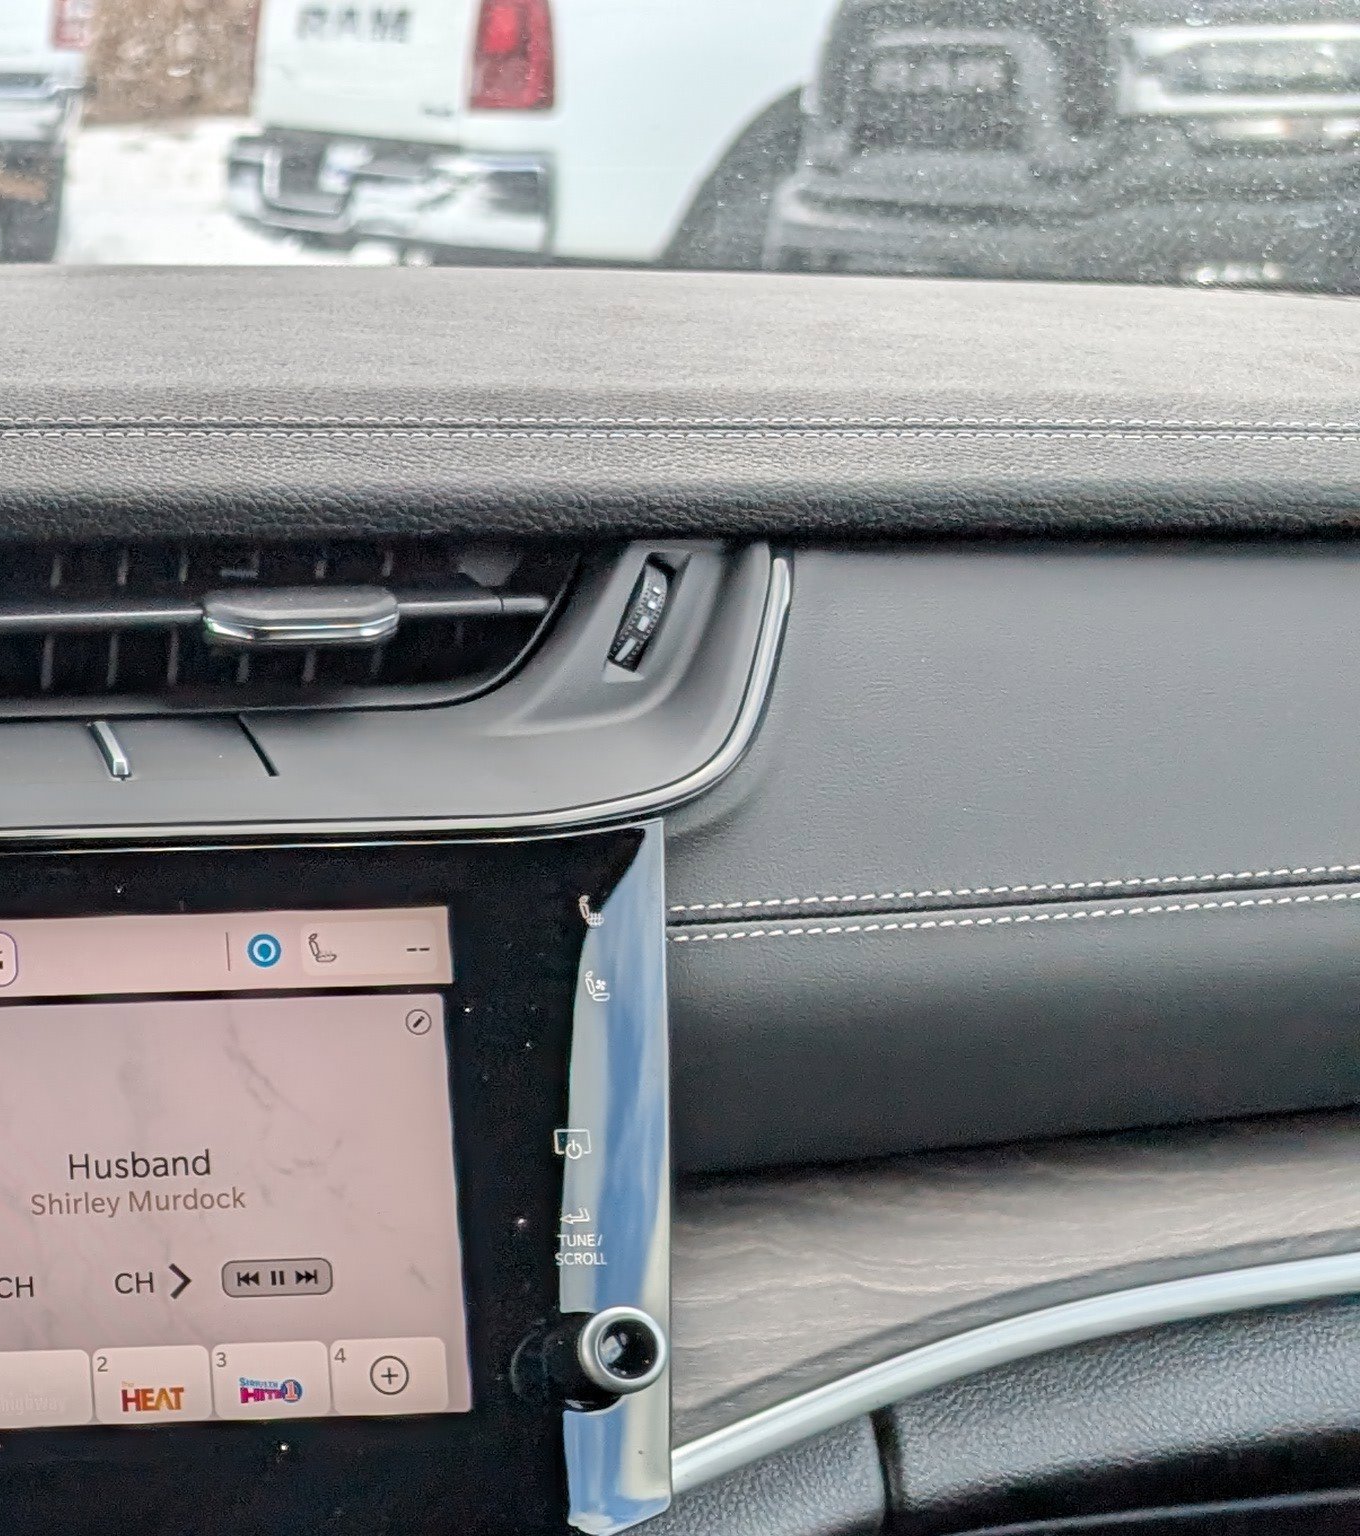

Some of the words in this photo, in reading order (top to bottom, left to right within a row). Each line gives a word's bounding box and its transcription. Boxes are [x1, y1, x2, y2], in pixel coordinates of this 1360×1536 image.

[68, 1149, 212, 1181] Husband
[31, 1190, 120, 1219] Shirley
[128, 1186, 247, 1215] Murdock
[556, 1233, 603, 1247] TUNE/
[554, 1252, 608, 1266] SCROLL
[114, 1271, 155, 1295] CH
[96, 1356, 108, 1372] 2
[216, 1352, 227, 1367] 3
[334, 1348, 347, 1364] 4
[121, 1387, 184, 1412] HEAT
